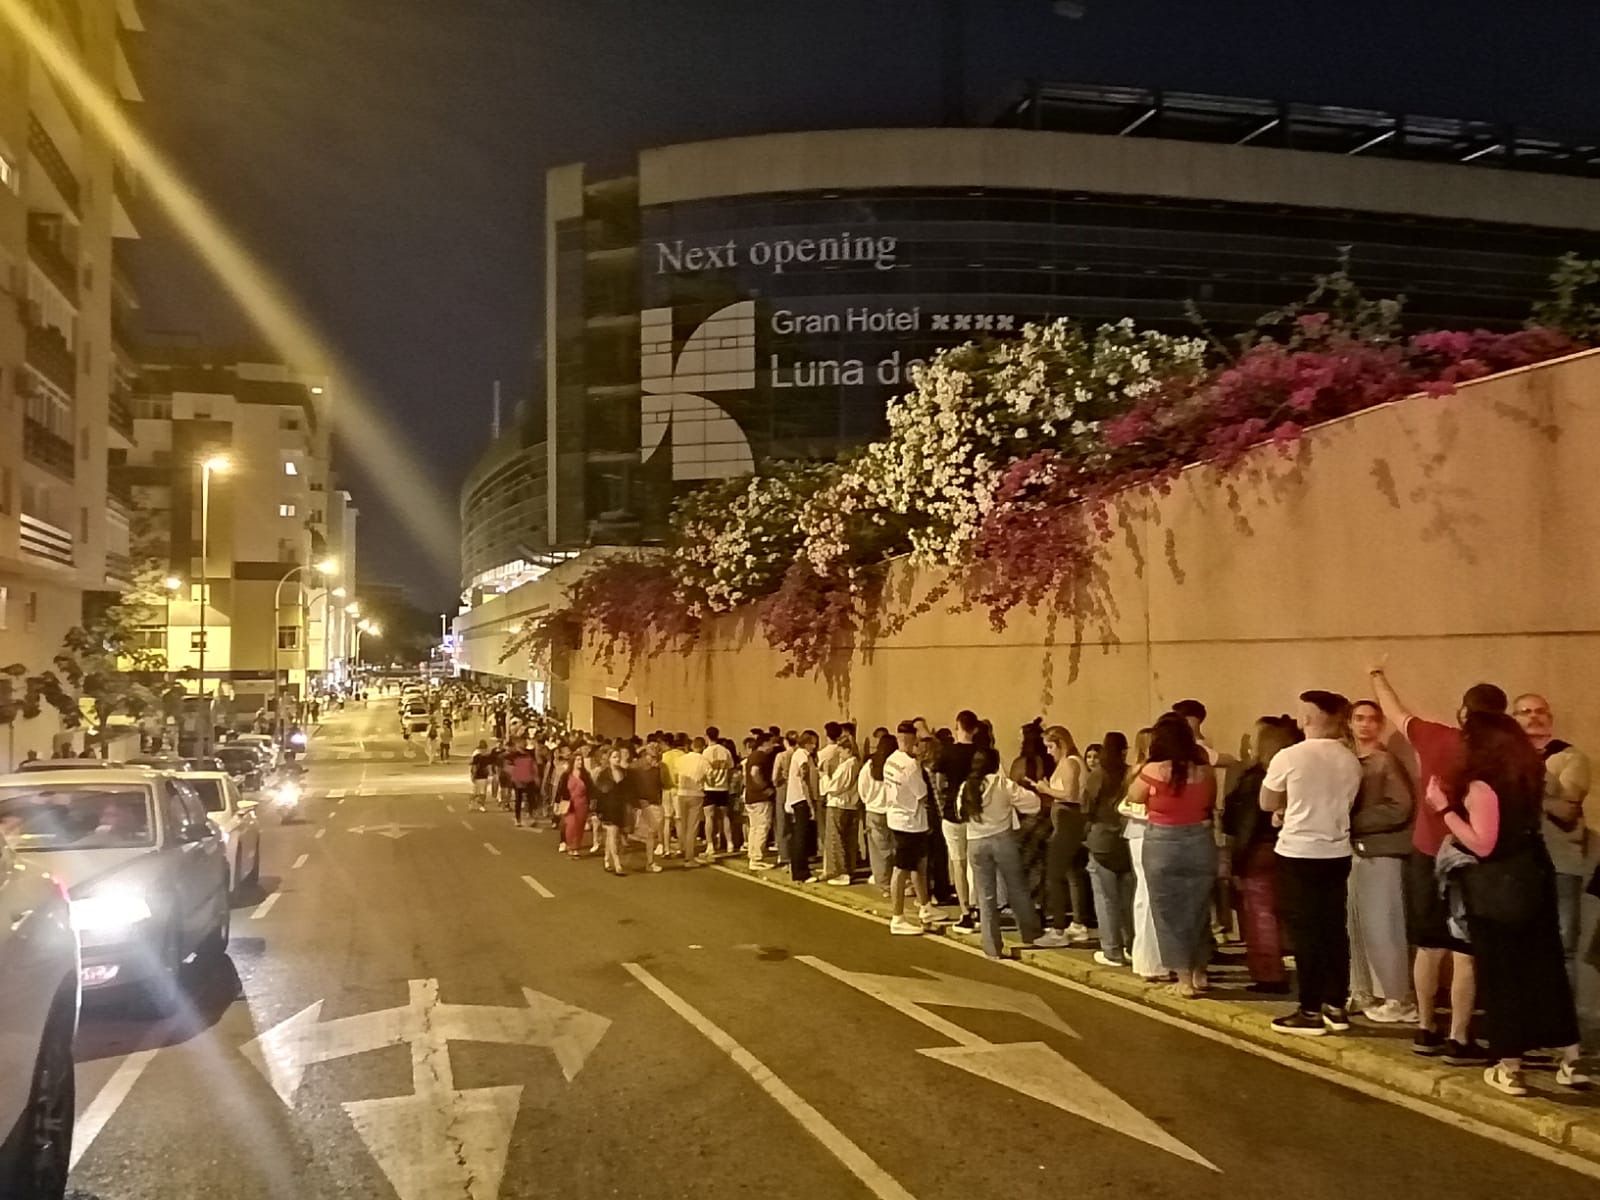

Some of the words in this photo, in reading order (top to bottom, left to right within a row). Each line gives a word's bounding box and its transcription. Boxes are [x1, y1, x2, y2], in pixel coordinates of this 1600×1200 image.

[656, 239, 738, 274] Next
[749, 231, 898, 274] opening
[771, 309, 841, 335] Gran
[847, 306, 920, 332] Hotel
[770, 353, 864, 388] Luna
